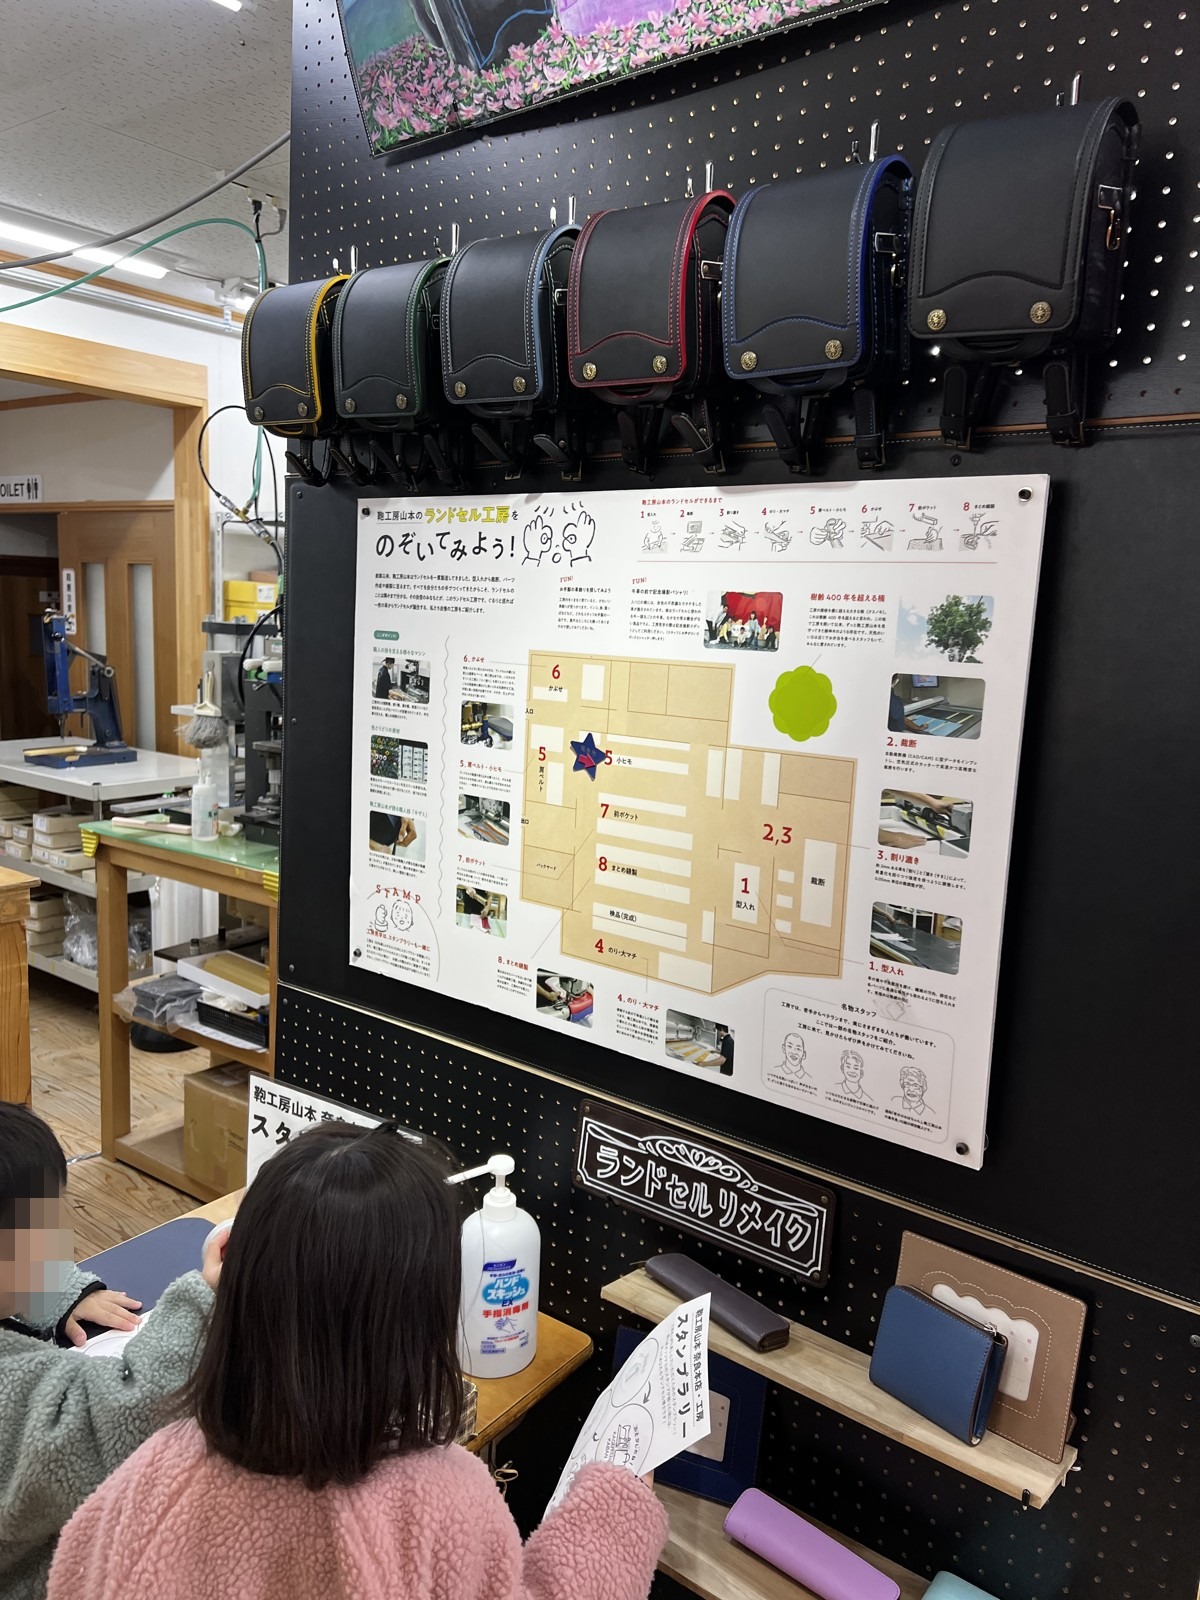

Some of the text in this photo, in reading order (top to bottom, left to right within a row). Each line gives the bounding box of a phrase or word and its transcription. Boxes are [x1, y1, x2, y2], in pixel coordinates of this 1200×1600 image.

[642, 497, 723, 506] 鞄工房山本のランドセルができるまで
[908, 503, 915, 512] 7
[963, 502, 970, 511] 8
[679, 510, 685, 518] 2
[719, 508, 725, 517] 3
[761, 507, 767, 516] 4
[810, 506, 816, 515] 5
[861, 504, 868, 513] 6
[551, 664, 561, 680] 6
[548, 685, 563, 693] かぶせ
[886, 736, 917, 749] 2. 裁断
[538, 746, 546, 762] 5
[603, 750, 613, 766] 5
[615, 756, 633, 766] 小ヒモ
[600, 803, 639, 821] 7 前ポケット
[762, 823, 793, 846] 2,3
[876, 850, 888, 861] 3.
[598, 856, 638, 876] 8 まとめ縫製
[740, 877, 751, 894] 1
[810, 876, 826, 887] 裁断
[376, 884, 421, 904] STAMP
[735, 900, 756, 911] 型入れ
[594, 938, 637, 959] 4 のり・大マチ
[881, 963, 905, 976] 型入れ
[841, 1003, 877, 1018] 名物スタッフ
[253, 1085, 317, 1122] 鞄工房山本
[494, 1275, 520, 1289] ハンド
[486, 1285, 526, 1301] スキッシュ
[501, 1298, 514, 1308] EX
[482, 1301, 529, 1319] 手指消毒剤
[675, 1313, 691, 1439] スタンプラリー
